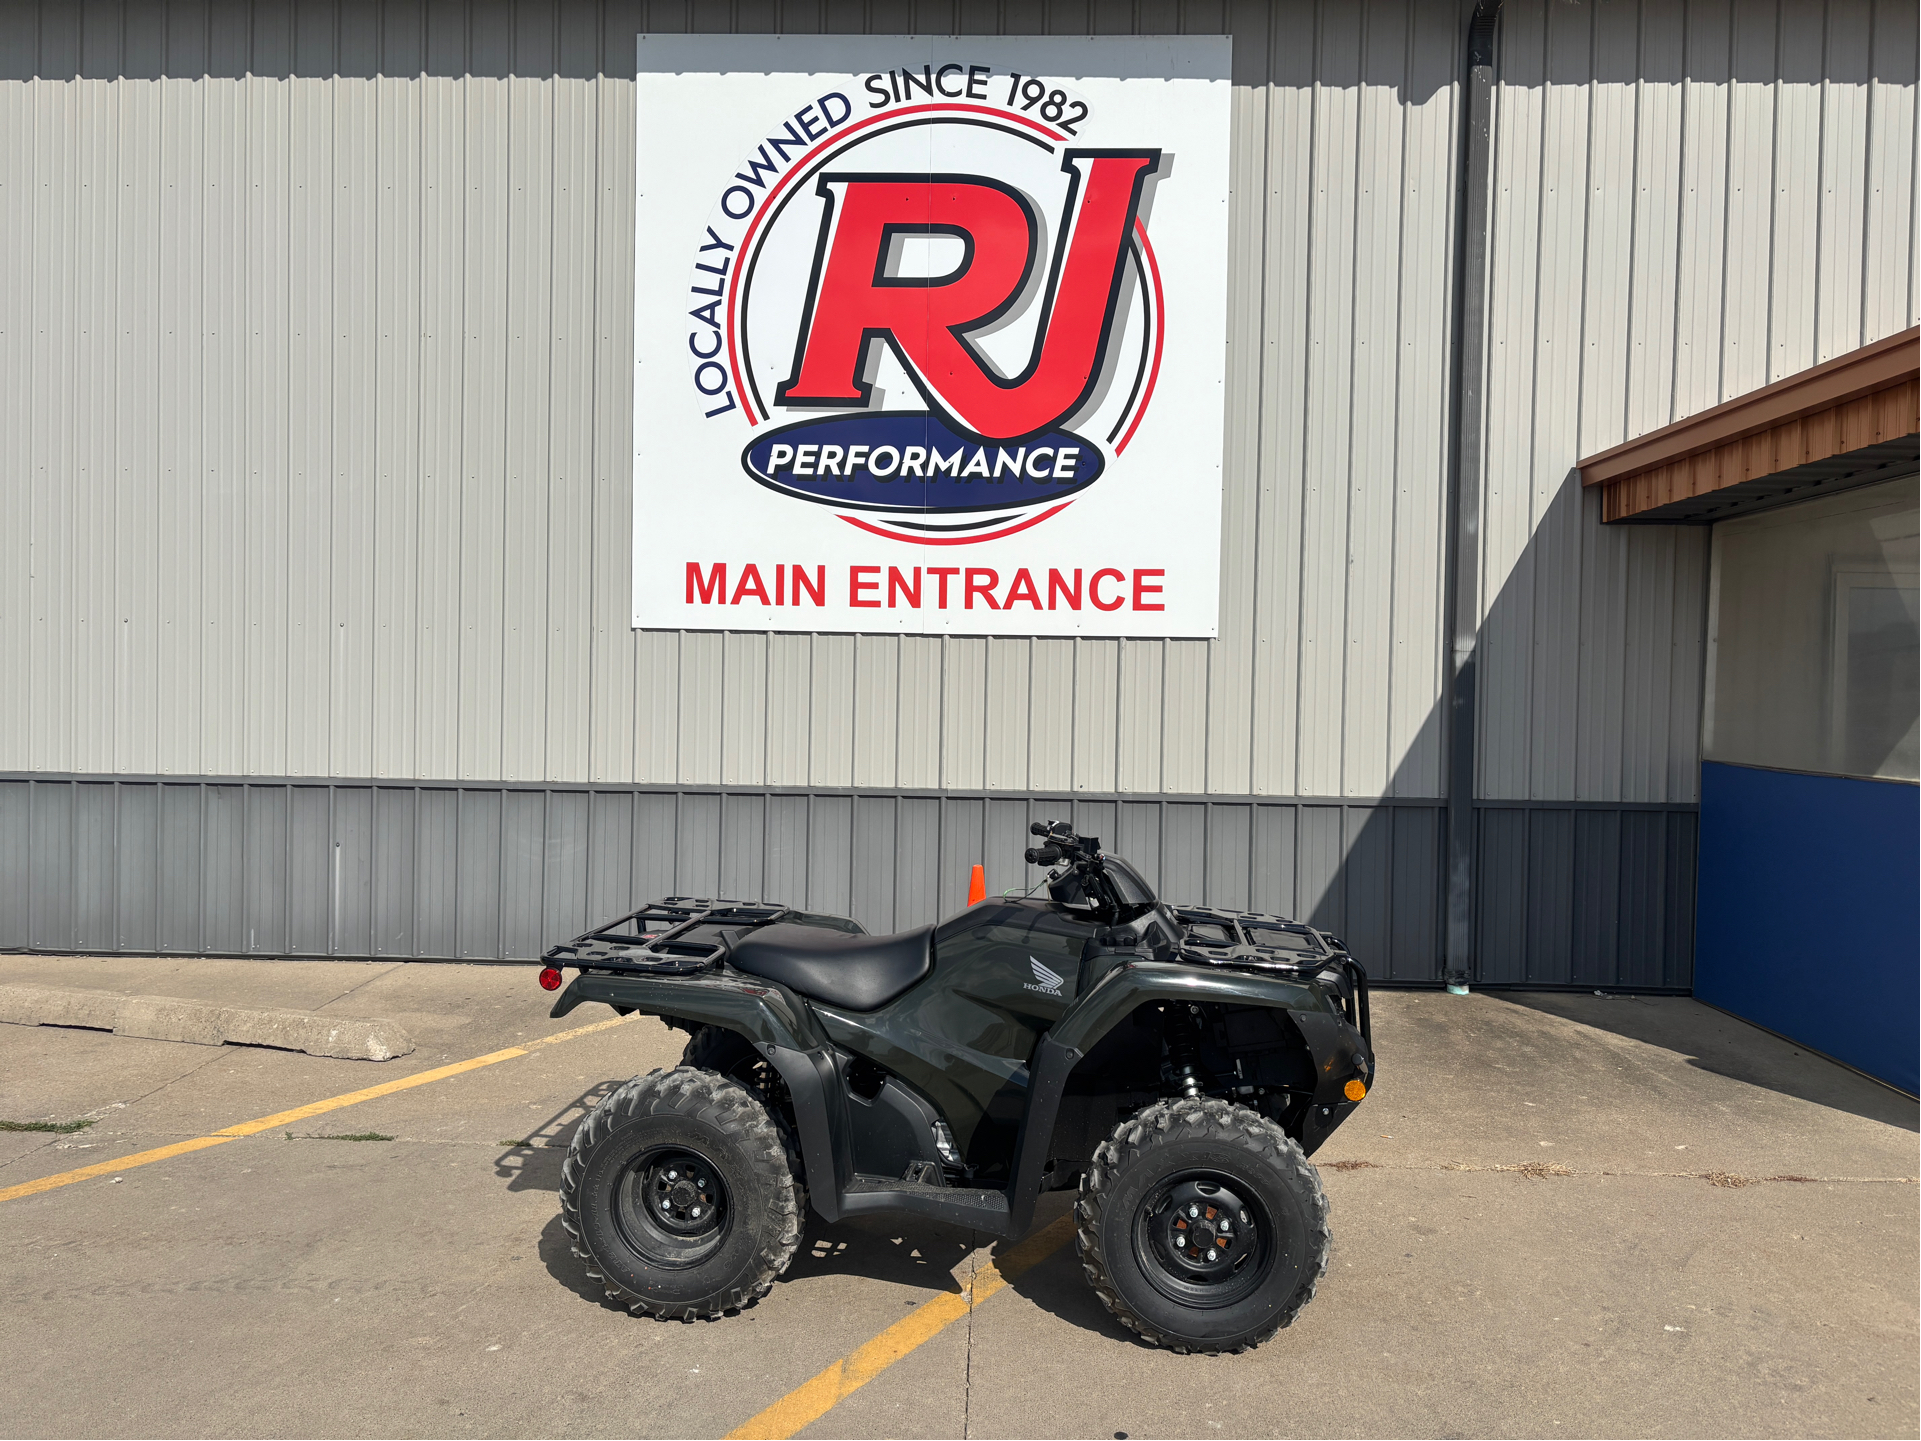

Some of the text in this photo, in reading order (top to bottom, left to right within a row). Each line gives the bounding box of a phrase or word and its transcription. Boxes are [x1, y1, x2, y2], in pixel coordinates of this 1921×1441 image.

[689, 64, 1088, 418] LOCALLY OWNED SINCE 1982
[774, 148, 1162, 444] RJ
[767, 444, 1079, 478] PERFORMANCE
[686, 562, 1165, 611] MAIN ENTRANCE
[1023, 982, 1062, 997] HONDA
